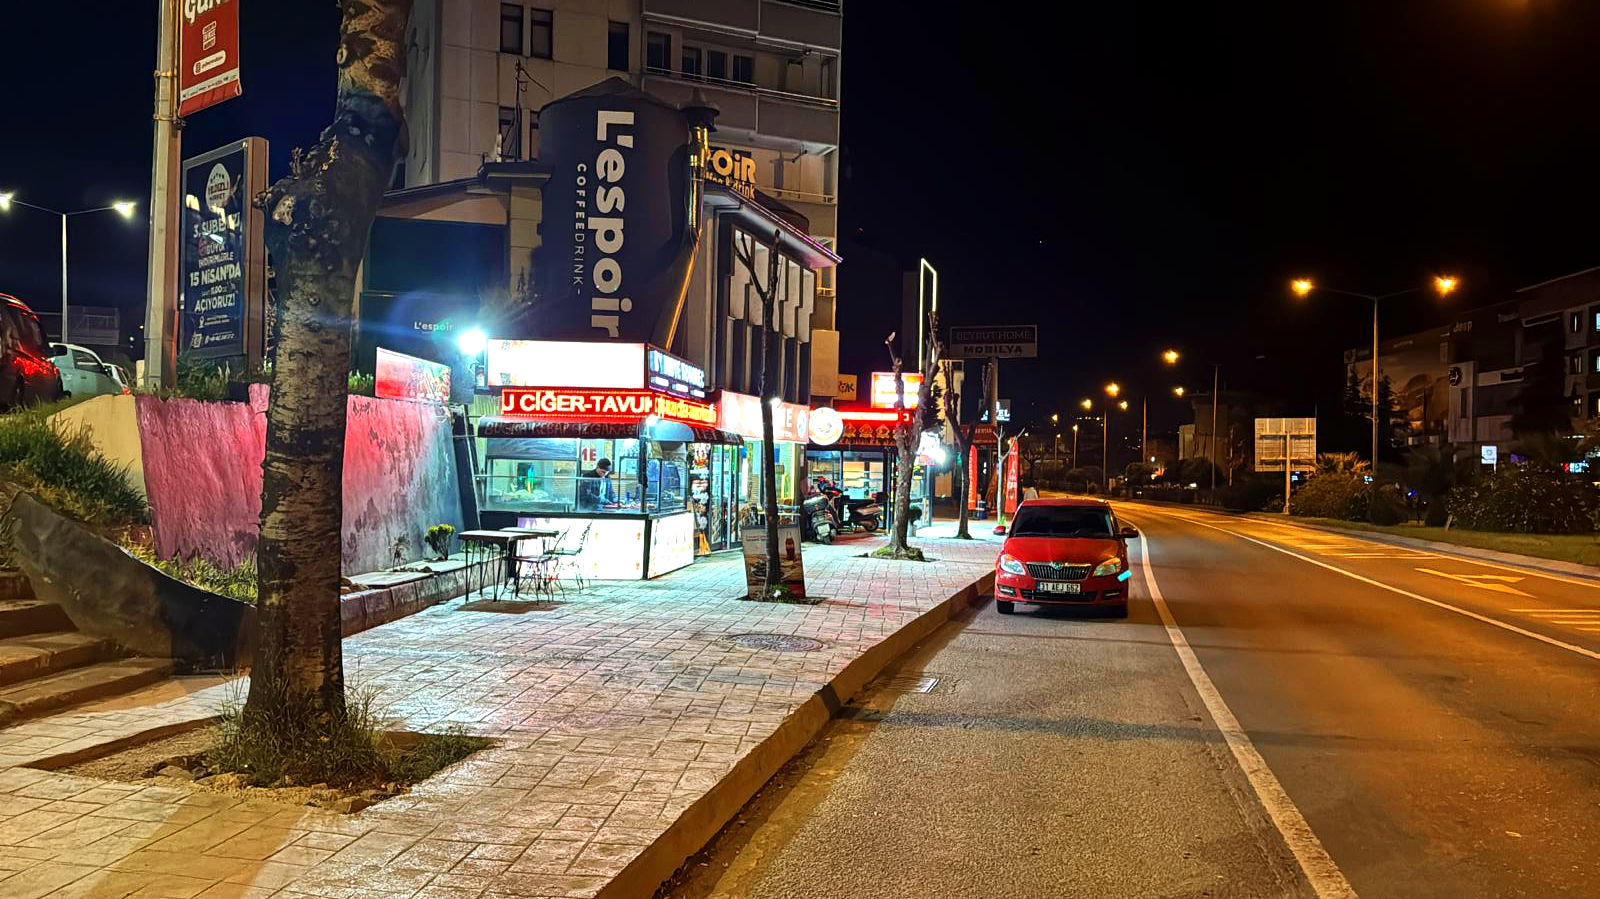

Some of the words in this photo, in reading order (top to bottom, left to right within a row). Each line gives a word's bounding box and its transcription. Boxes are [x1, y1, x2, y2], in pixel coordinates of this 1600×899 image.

[588, 110, 635, 338] L'espoir
[190, 272, 200, 287] 15
[414, 321, 453, 332] L'espoir
